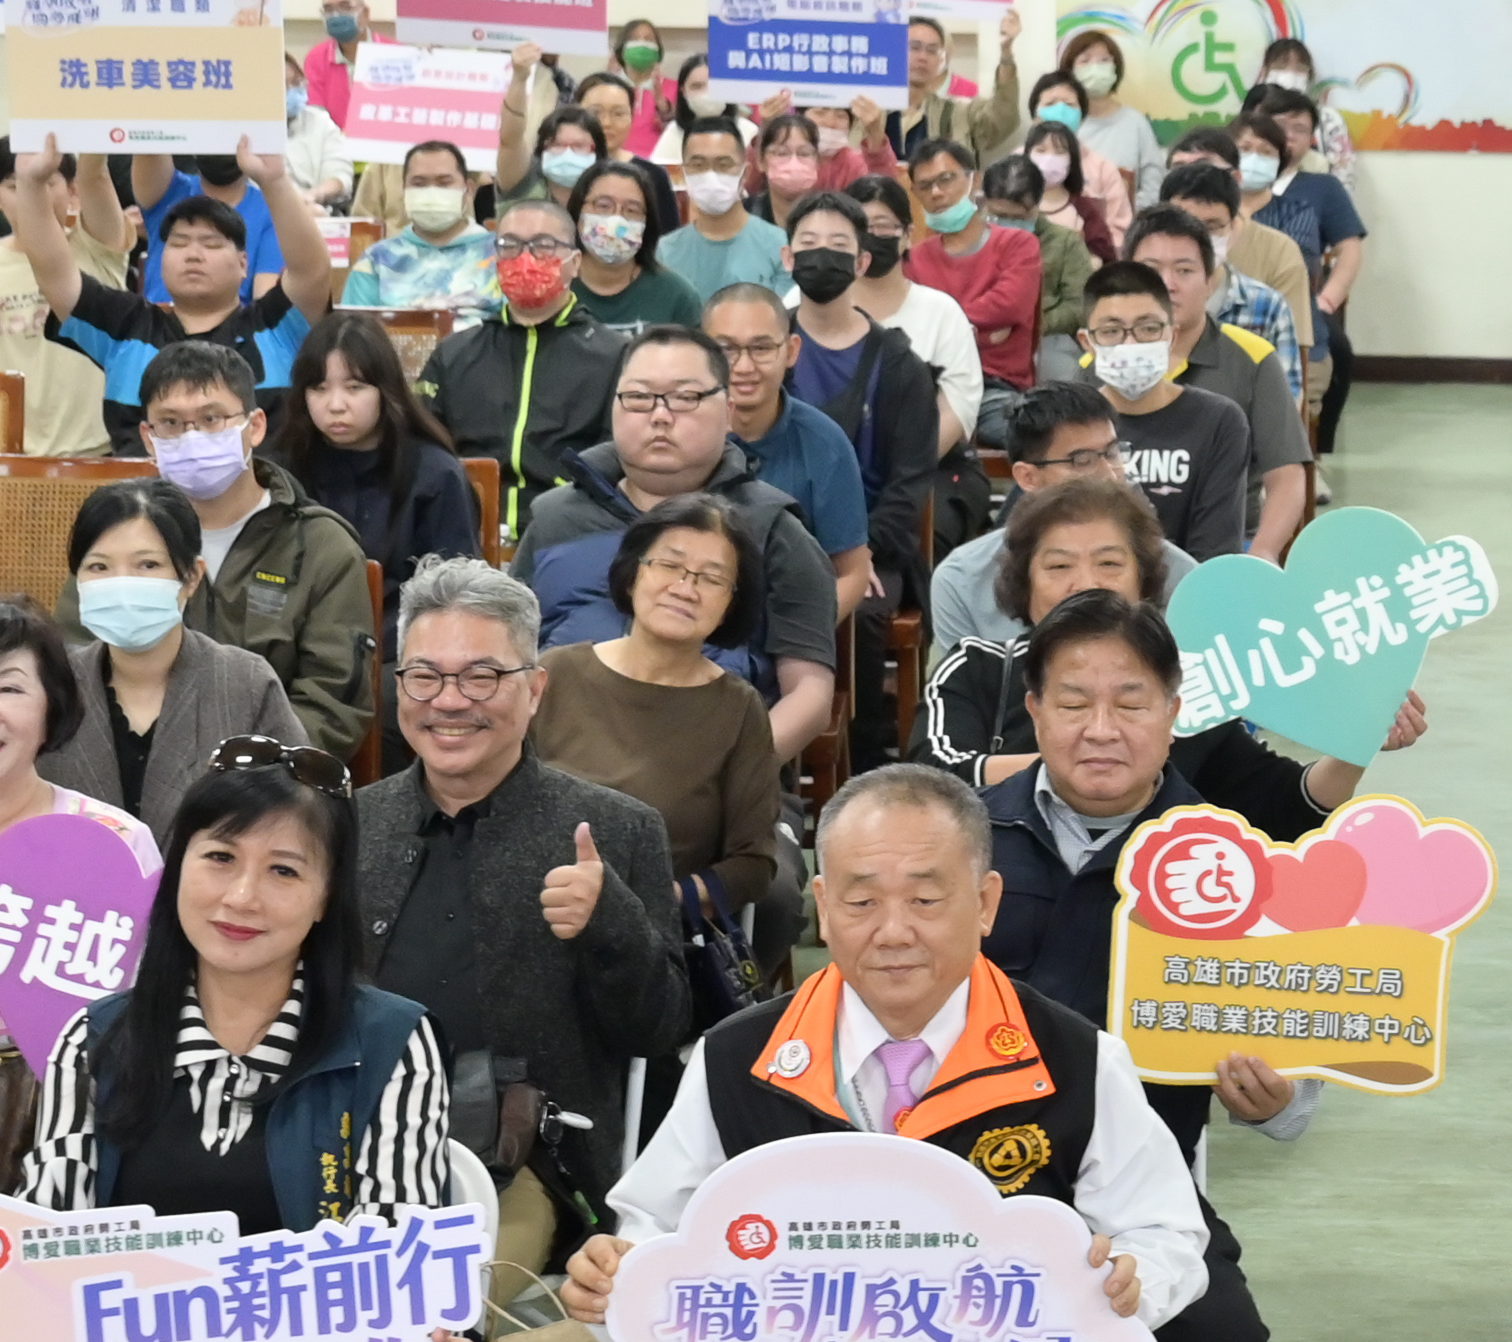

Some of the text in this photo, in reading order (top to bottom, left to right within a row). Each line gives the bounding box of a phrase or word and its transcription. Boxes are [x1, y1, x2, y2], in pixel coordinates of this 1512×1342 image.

[59, 58, 234, 91] 洗車美容班
[1178, 546, 1489, 732] 創心就業
[1162, 955, 1404, 998] 高雄市政府勞工局
[1130, 996, 1432, 1047] 博愛職業技能訓練中心
[20, 1219, 142, 1241] 高雄市政府勞工局
[787, 1219, 901, 1232] 高雄市政府勞工局
[787, 1231, 980, 1251] 博愛職業技能訓練中心
[22, 1228, 226, 1262] 博愛職業技能訓練中心
